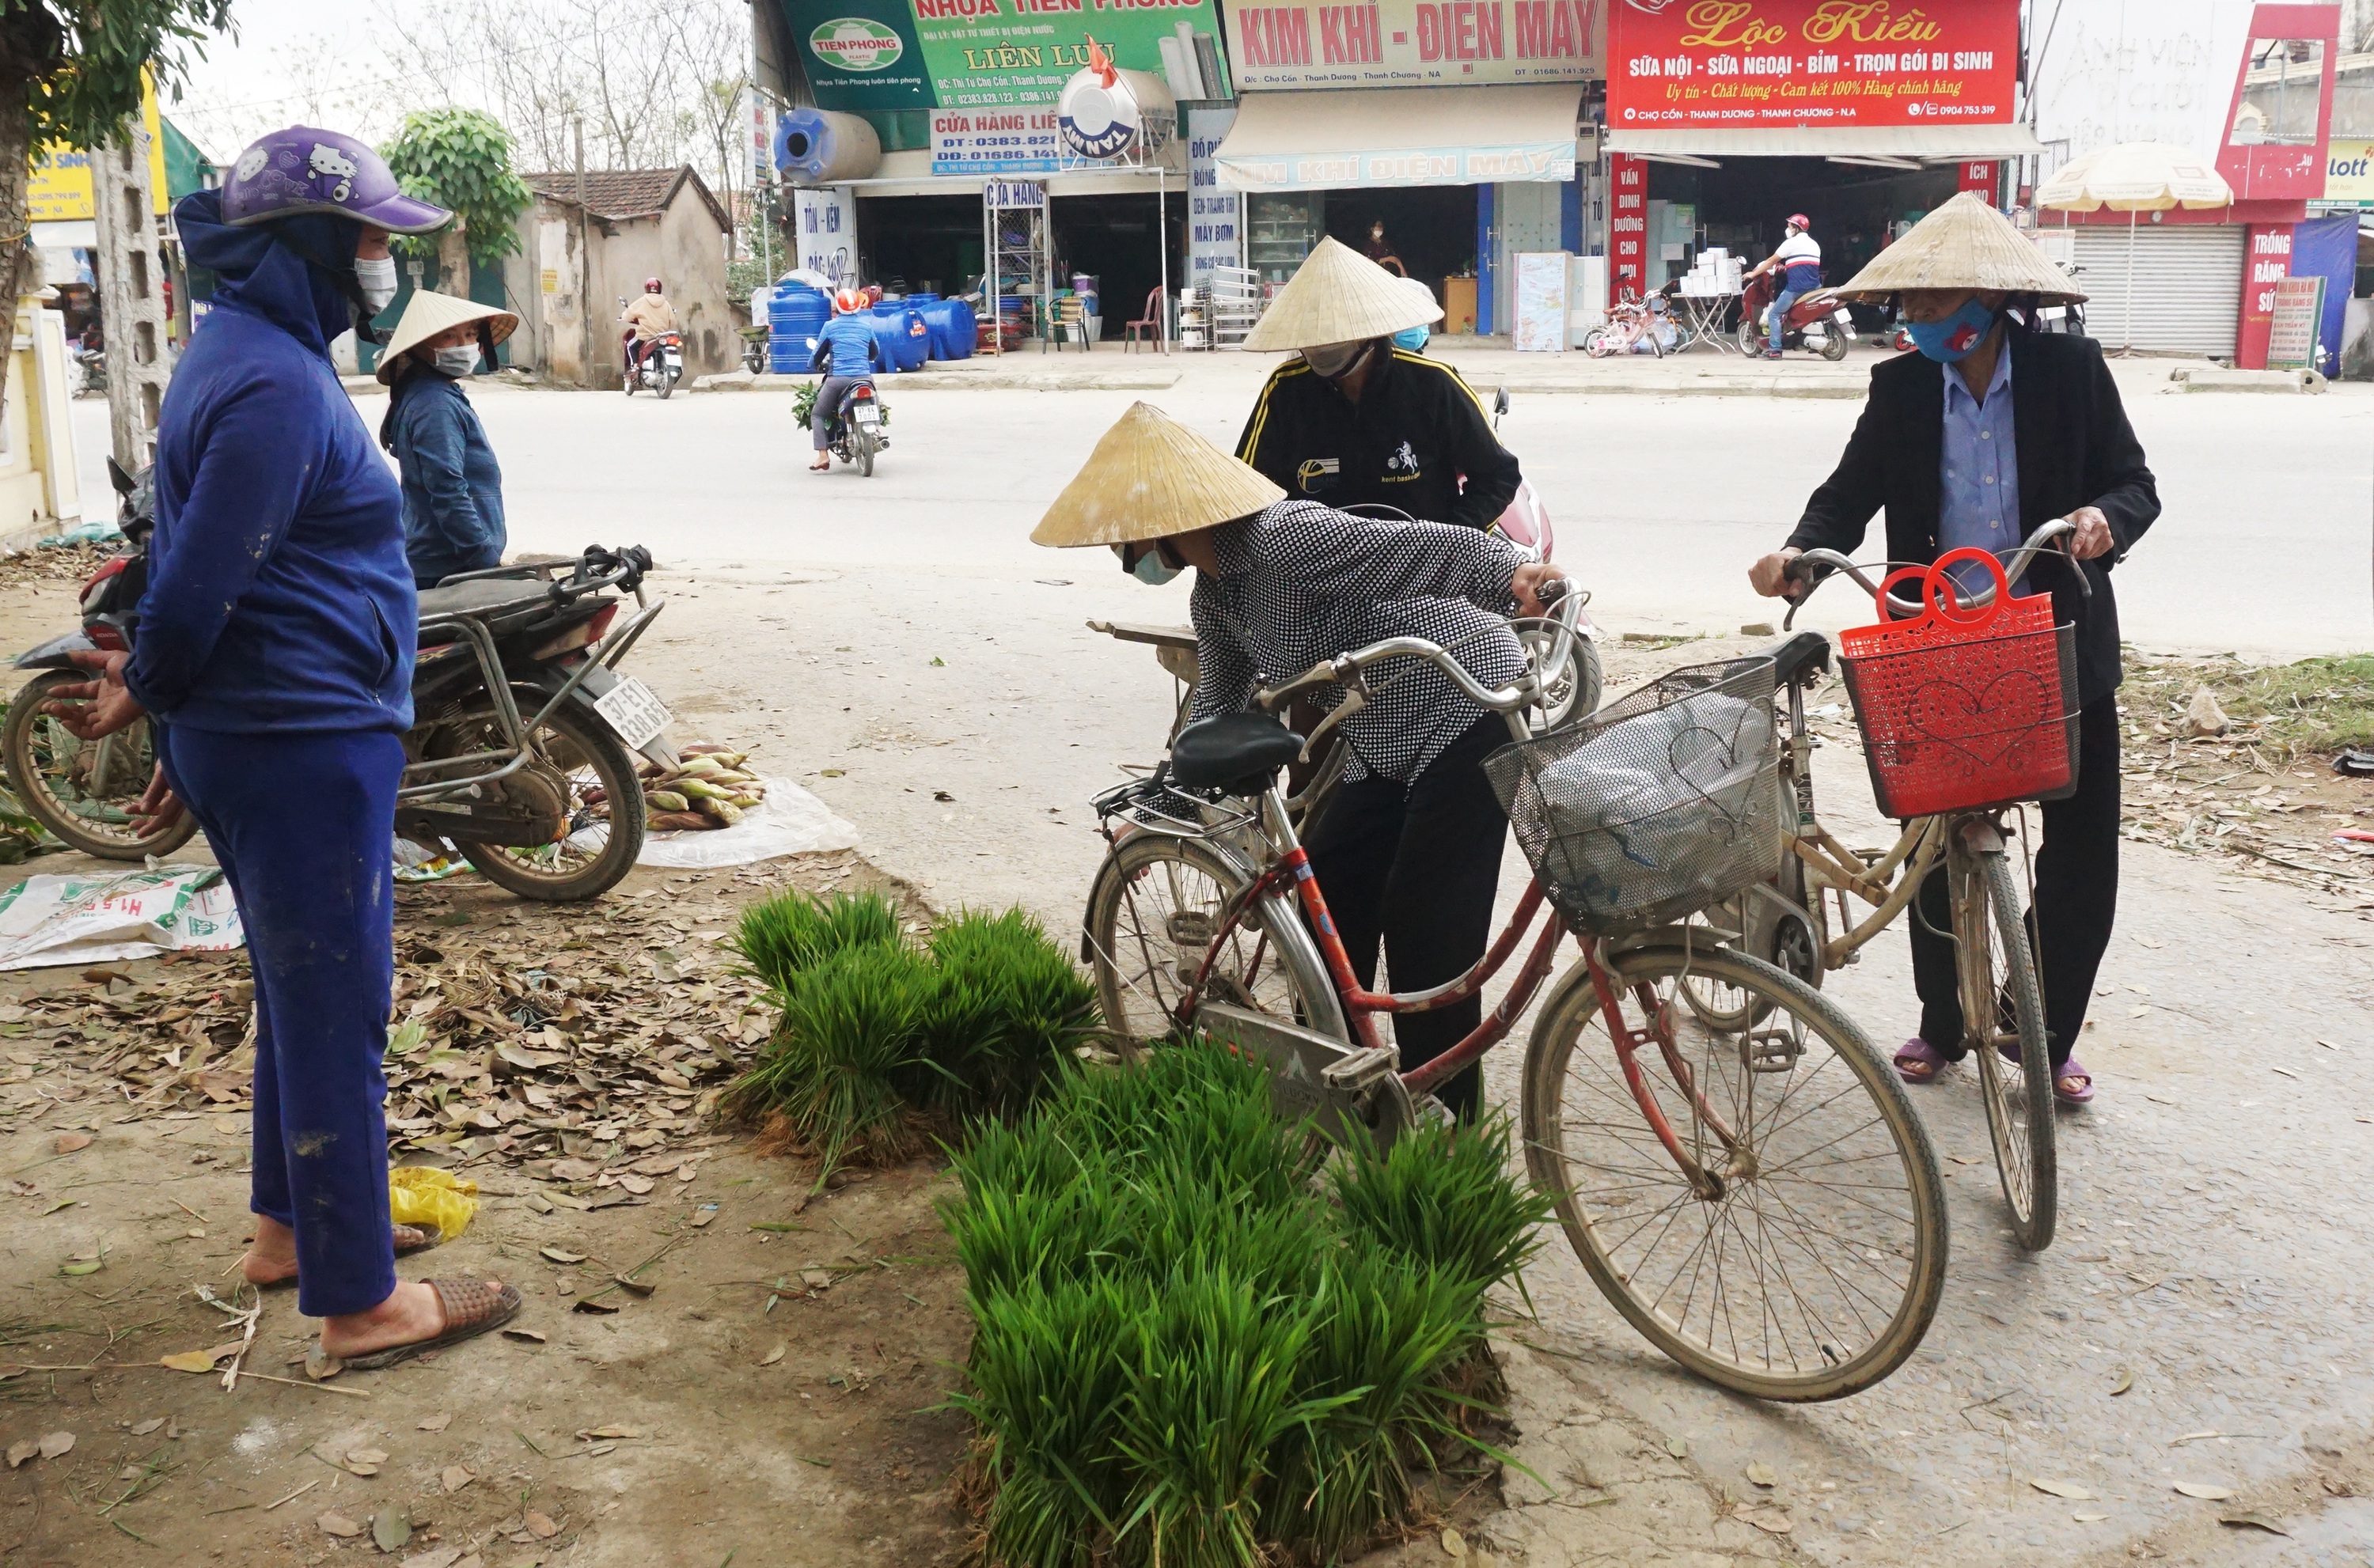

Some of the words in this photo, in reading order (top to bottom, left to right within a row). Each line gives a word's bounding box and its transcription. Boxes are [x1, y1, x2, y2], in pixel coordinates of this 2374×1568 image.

[1032, 23, 1055, 35] NƯỚC
[1239, 6, 1313, 67] KIM
[1319, 0, 1383, 65] KHÍ
[1680, 0, 1788, 52] Lộc
[1803, 0, 1942, 43] Kiều
[816, 40, 848, 51] TIEN
[850, 38, 897, 51] PHONG
[963, 40, 1043, 70] LIÊN
[1629, 55, 1660, 76] SỮA
[1664, 55, 1692, 79] NỘI
[1708, 54, 1739, 75] SỮA
[1743, 55, 1792, 78] NGOẠI
[1807, 50, 1838, 74] BỈM
[1854, 53, 1896, 76] TRỌN
[1901, 48, 1928, 71] GÓI
[1932, 52, 1948, 70] ĐI
[1953, 51, 1993, 70] SINH
[977, 76, 992, 89] Chợ
[1011, 75, 1036, 86] Thanh
[1264, 75, 1280, 85] Chợ
[1390, 71, 1421, 80] Chương
[958, 93, 1014, 104] 02383.828.123
[1666, 83, 1681, 101] Uy
[1685, 83, 1700, 99] tín
[1711, 82, 1739, 98] Chất
[1740, 83, 1772, 100] lượng
[1780, 81, 1807, 97] Cam
[1810, 80, 1829, 97] kết
[1831, 79, 1861, 96] 100%
[1863, 79, 1895, 98] Hàng
[1898, 78, 1929, 95] chính
[1932, 79, 1963, 97] hãng
[1638, 111, 1659, 122] CHỢ
[1690, 110, 1720, 119] THANH
[1721, 109, 1754, 119] DƯƠNG
[1762, 108, 1791, 118] THANH
[1793, 108, 1834, 118] CHƯƠNG
[1841, 108, 1856, 116] N.A
[1940, 106, 1963, 115] 0904
[1981, 105, 1996, 114] 319
[935, 111, 971, 133] CỬA
[976, 112, 1025, 131] HÀNG
[1194, 165, 1216, 186] BÓNG
[1298, 155, 1361, 183] KHÍ
[1369, 153, 1457, 183] ĐIỆN
[1468, 150, 1553, 176] MÁY
[1969, 162, 1988, 180] ÍCH
[1621, 167, 1639, 185] VẤN
[1619, 195, 1640, 209] DINH
[1195, 222, 1213, 243] MÁY
[1215, 222, 1234, 242] BƠM
[1614, 214, 1644, 233] DƯỠNG
[1620, 241, 1637, 256] CHO
[1620, 264, 1636, 281] MỌI
[2254, 259, 2285, 283] RĂNG
[620, 701, 668, 744] 338.65
